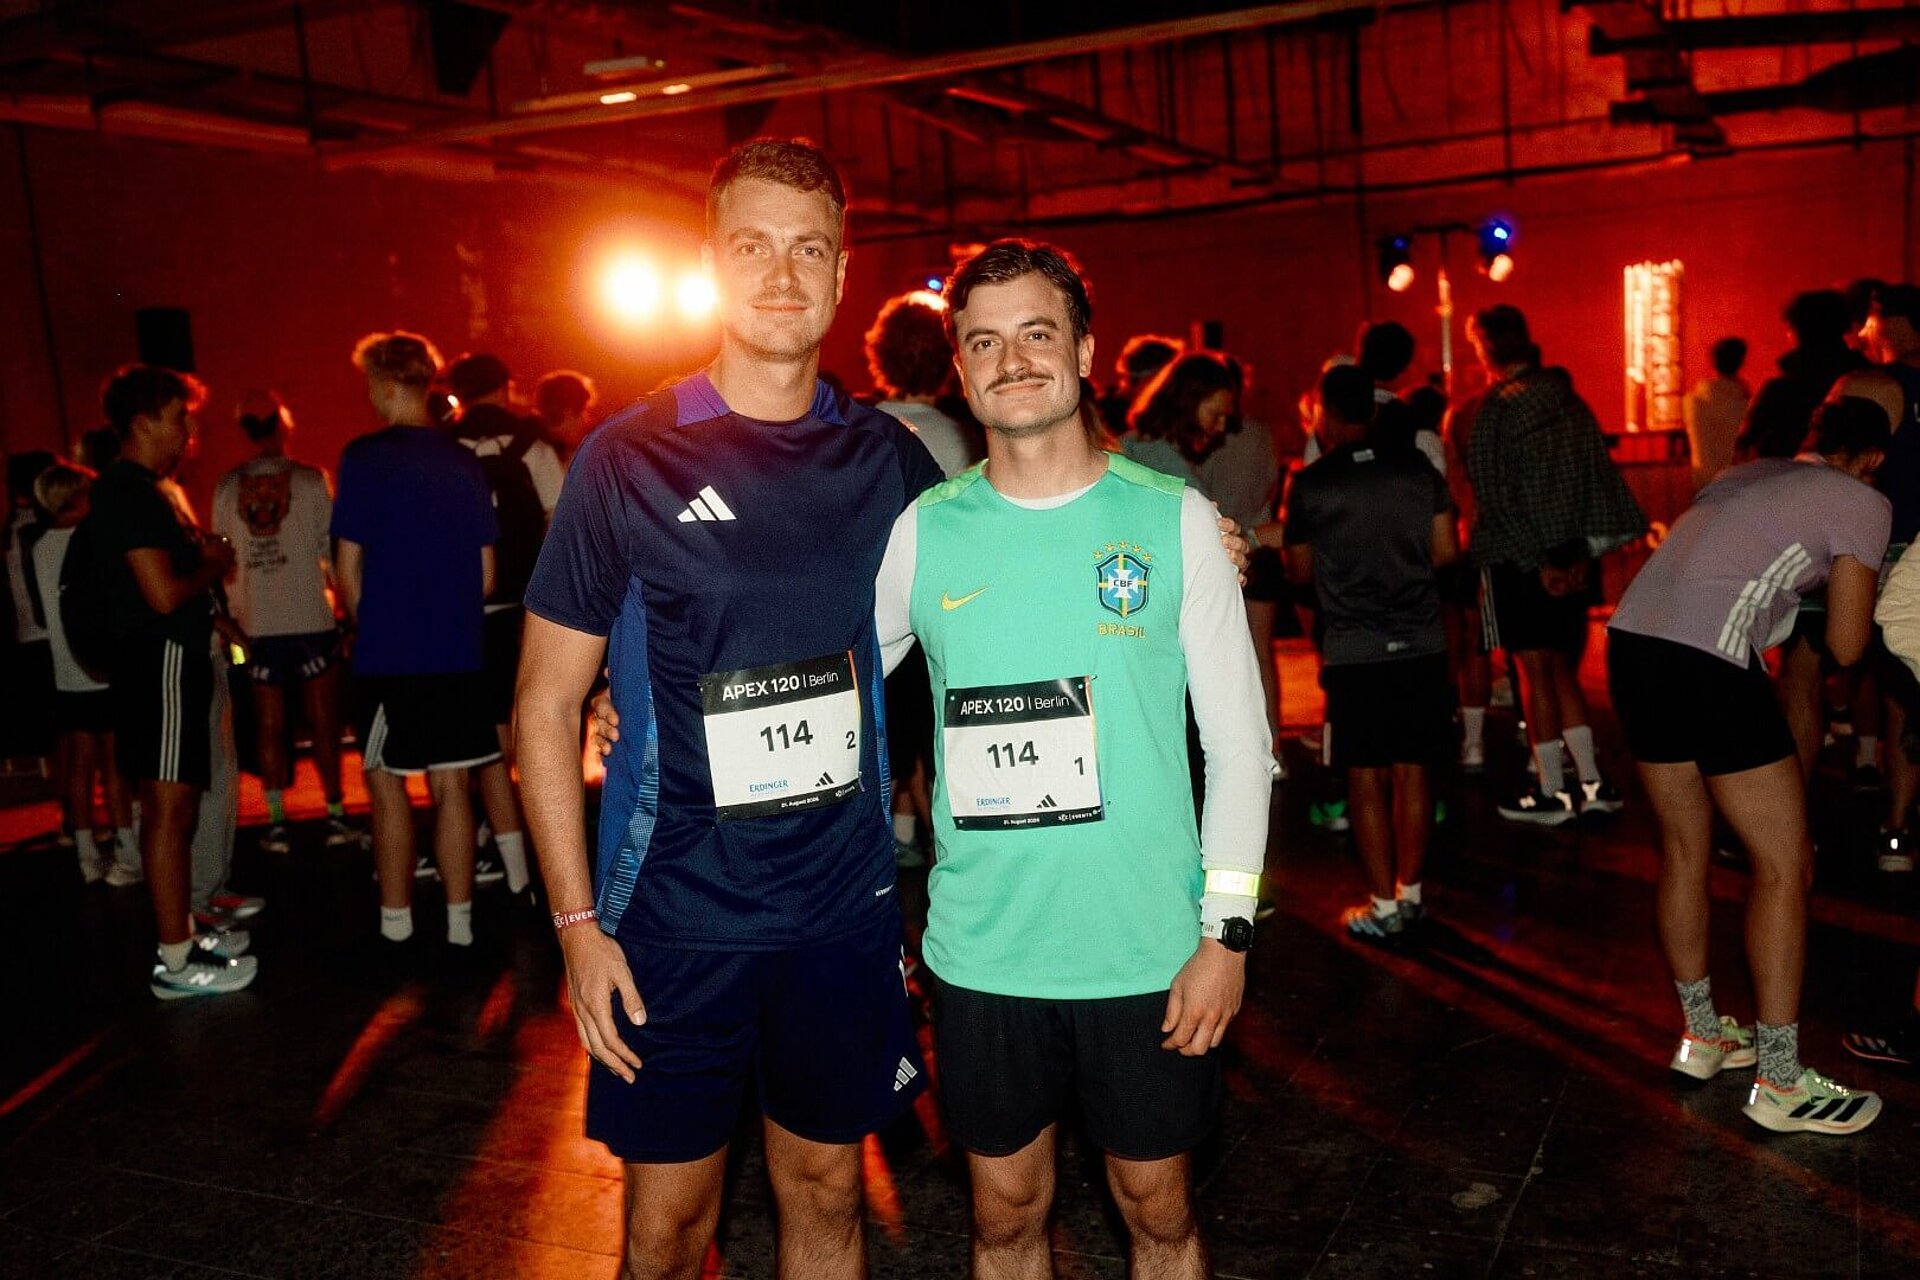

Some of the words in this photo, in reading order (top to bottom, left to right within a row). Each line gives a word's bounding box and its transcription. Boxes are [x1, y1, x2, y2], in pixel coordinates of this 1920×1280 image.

[1113, 579, 1133, 588] CBF
[1097, 623, 1146, 639] BRASIL
[722, 680, 769, 702] APEX
[771, 675, 800, 693] 120
[809, 671, 839, 687] Berlin
[960, 699, 994, 716] APEX
[996, 696, 1025, 713] 120
[1034, 695, 1070, 710] Berlin
[760, 719, 814, 752] 114
[845, 730, 857, 750] 2
[987, 740, 1039, 769] 114
[1074, 757, 1084, 776] 1
[749, 779, 789, 793] ERDINGER
[976, 797, 1011, 807] ERDINGER
